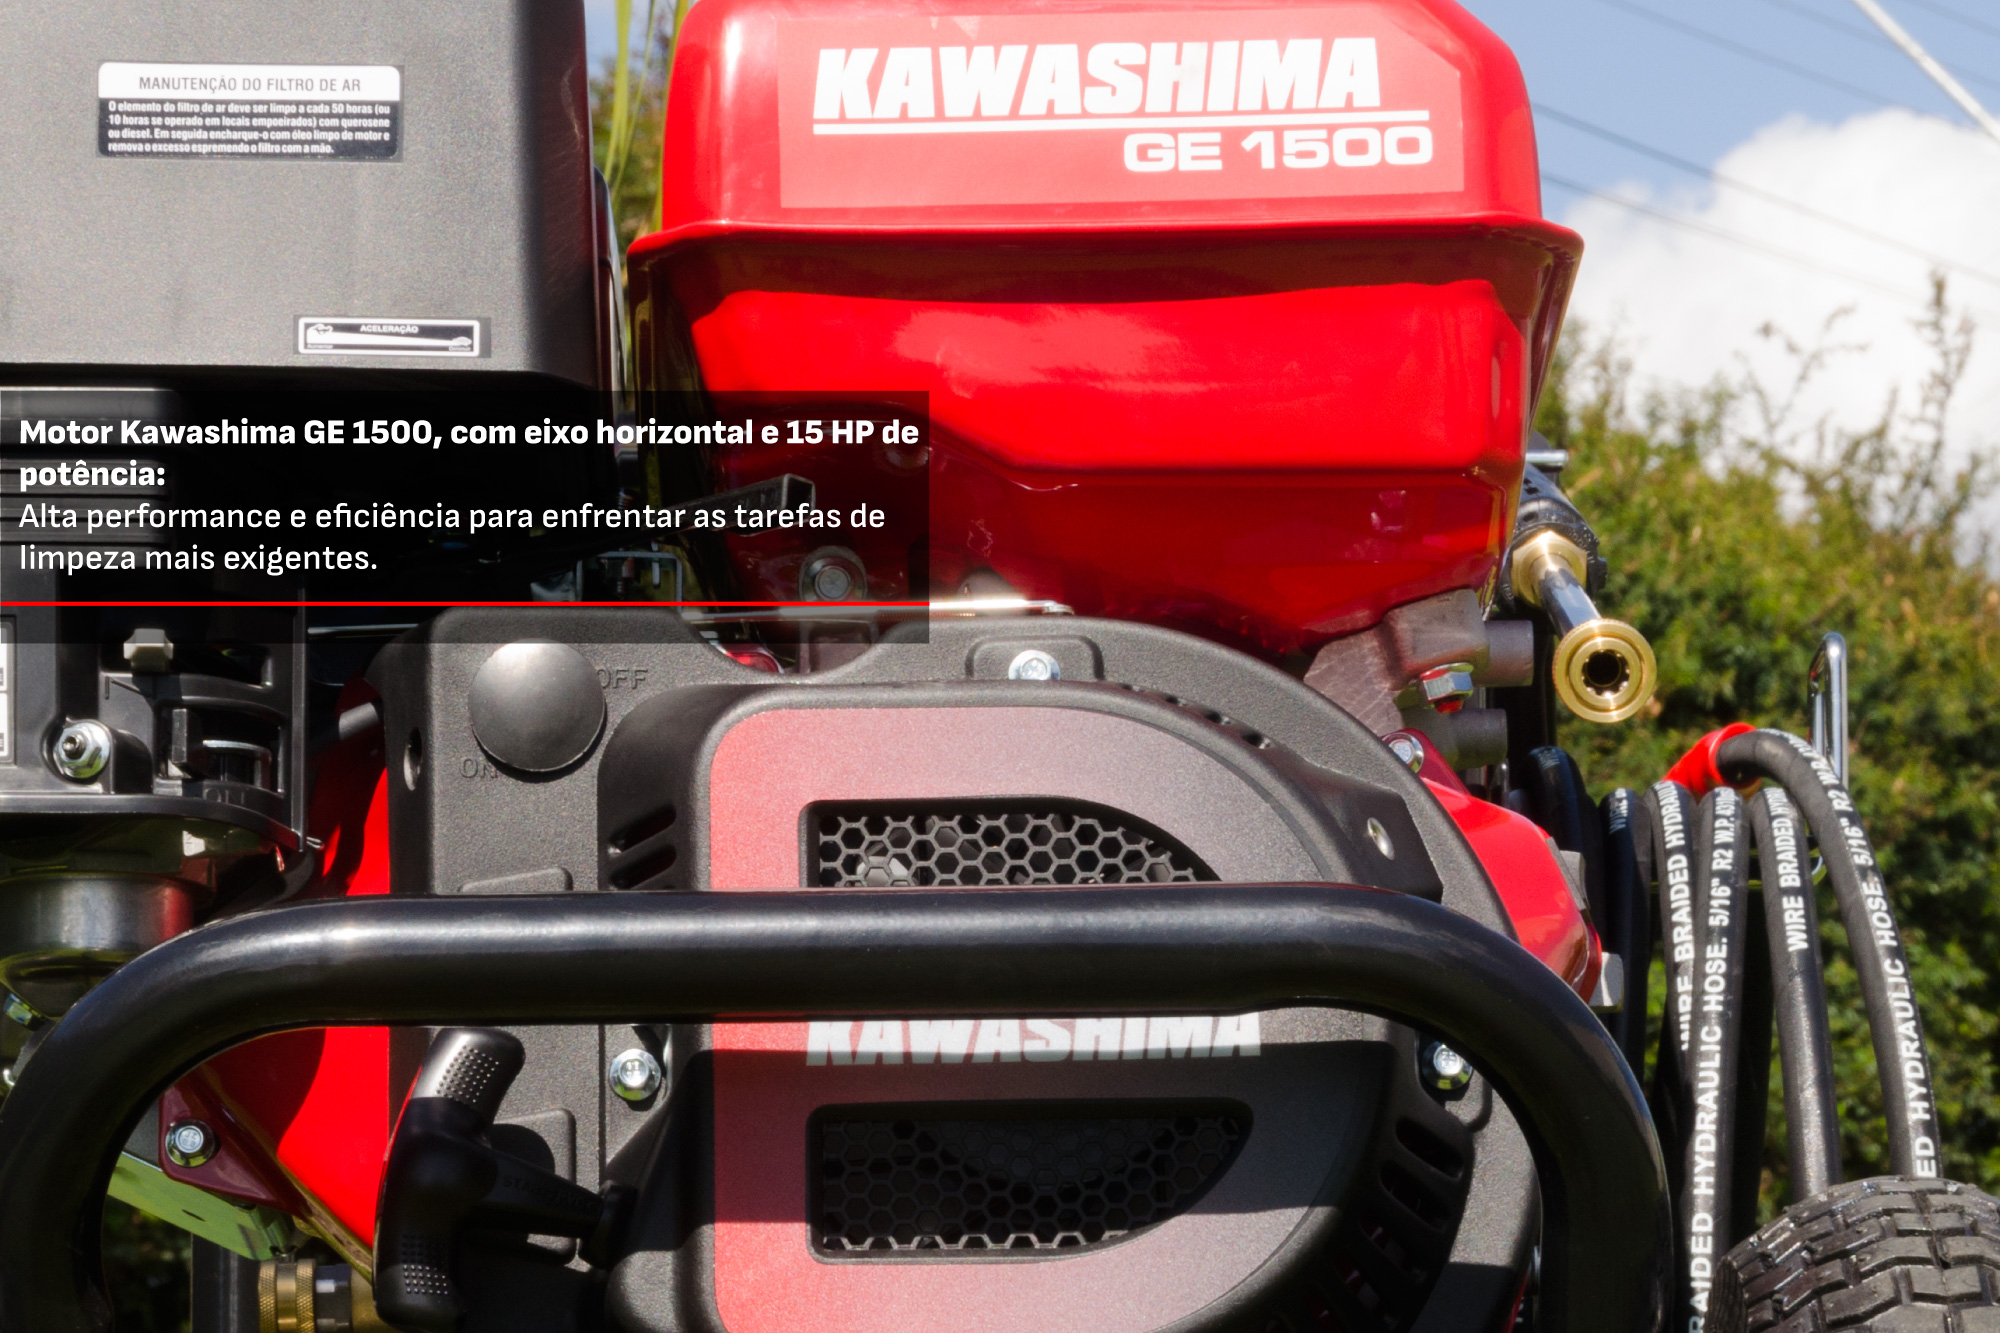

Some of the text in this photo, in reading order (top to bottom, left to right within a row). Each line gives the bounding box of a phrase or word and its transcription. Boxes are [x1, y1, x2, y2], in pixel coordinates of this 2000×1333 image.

[139, 75, 361, 94] MANUTENÇÃO DO FILTRO DE AR
[813, 37, 1381, 120] KAWASHIMA
[109, 114, 390, 129] 10 horas se operado em locais empoeirados) com querosene
[118, 101, 161, 112] elemento
[163, 101, 175, 112] do
[177, 102, 200, 113] filtro
[201, 102, 214, 113] de
[215, 104, 226, 113] ar
[227, 103, 251, 113] deve
[252, 105, 267, 113] ser
[269, 103, 297, 115] limpo
[306, 103, 330, 114] cada
[331, 103, 345, 114] 50
[346, 103, 373, 114] horas
[374, 104, 390, 115] (ou
[108, 130, 119, 139] ou
[121, 128, 153, 139] diesel.
[154, 128, 170, 139] Em
[170, 129, 208, 140] seguida
[209, 130, 269, 142] encharque-o
[270, 132, 291, 141] com
[291, 129, 313, 141] óleo
[313, 130, 340, 142] limpo
[341, 130, 353, 141] de
[354, 131, 382, 141] motor
[108, 143, 143, 152] remova
[152, 143, 190, 153] excesso
[191, 142, 250, 154] espremendo
[258, 142, 280, 153] filtro
[281, 144, 303, 153] com
[313, 144, 334, 154] mão.
[1123, 126, 1433, 173] GE 1500
[360, 324, 419, 335] ACELERAÇÃO
[1652, 780, 1686, 849] HYDRAUL
[1828, 790, 1853, 812] R2
[1712, 849, 1734, 871] R2
[1772, 818, 1801, 888] BRAIDED
[1667, 854, 1695, 962] BRAIDED
[1708, 877, 1731, 926] 5/16"
[1783, 896, 1808, 952] WIRE
[1862, 877, 1898, 946] HOSE.
[1703, 937, 1728, 1011] HOSE.
[806, 1012, 1261, 1066] KAWASHIMA
[1884, 958, 1931, 1121] HYDRAULIC
[1693, 1026, 1722, 1195] HYDRAULIC
[1915, 1136, 1938, 1178] ED
[1689, 1212, 1714, 1333] RAIDED
